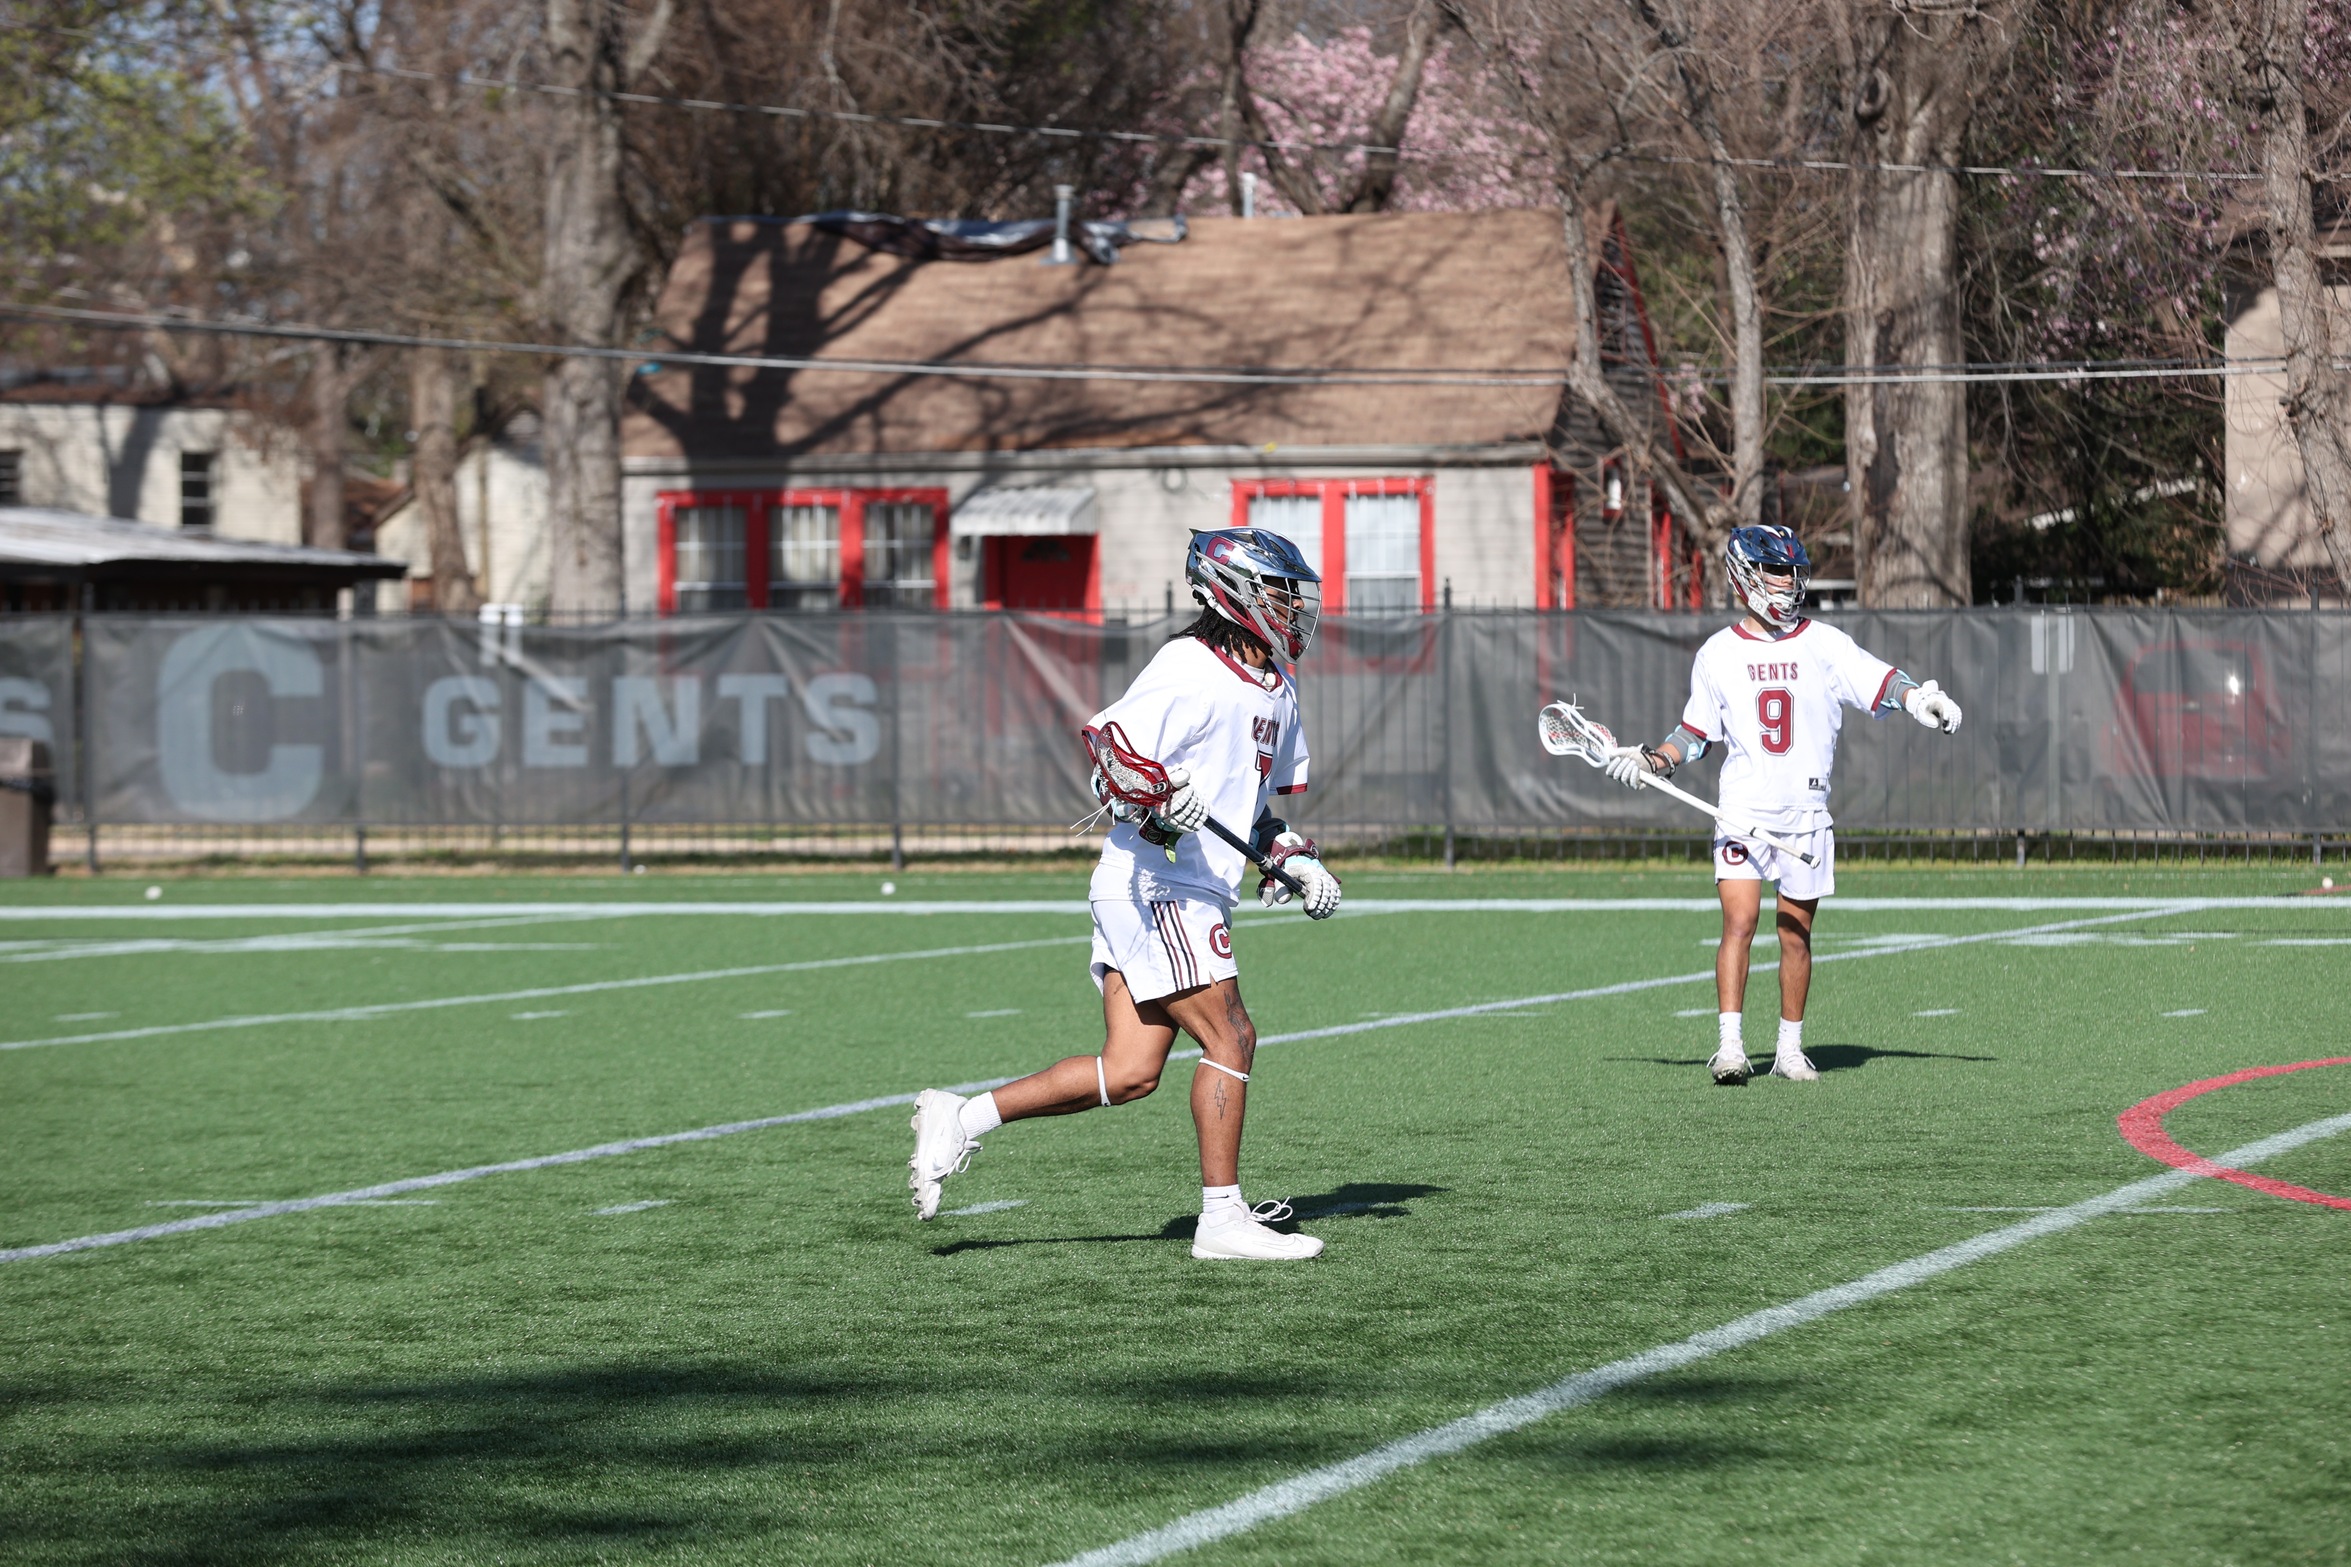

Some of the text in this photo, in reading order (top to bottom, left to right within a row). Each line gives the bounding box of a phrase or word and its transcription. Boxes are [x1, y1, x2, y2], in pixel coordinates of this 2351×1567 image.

[158, 624, 324, 821] C
[422, 673, 881, 768] GENTS
[1755, 687, 1794, 756] 9
